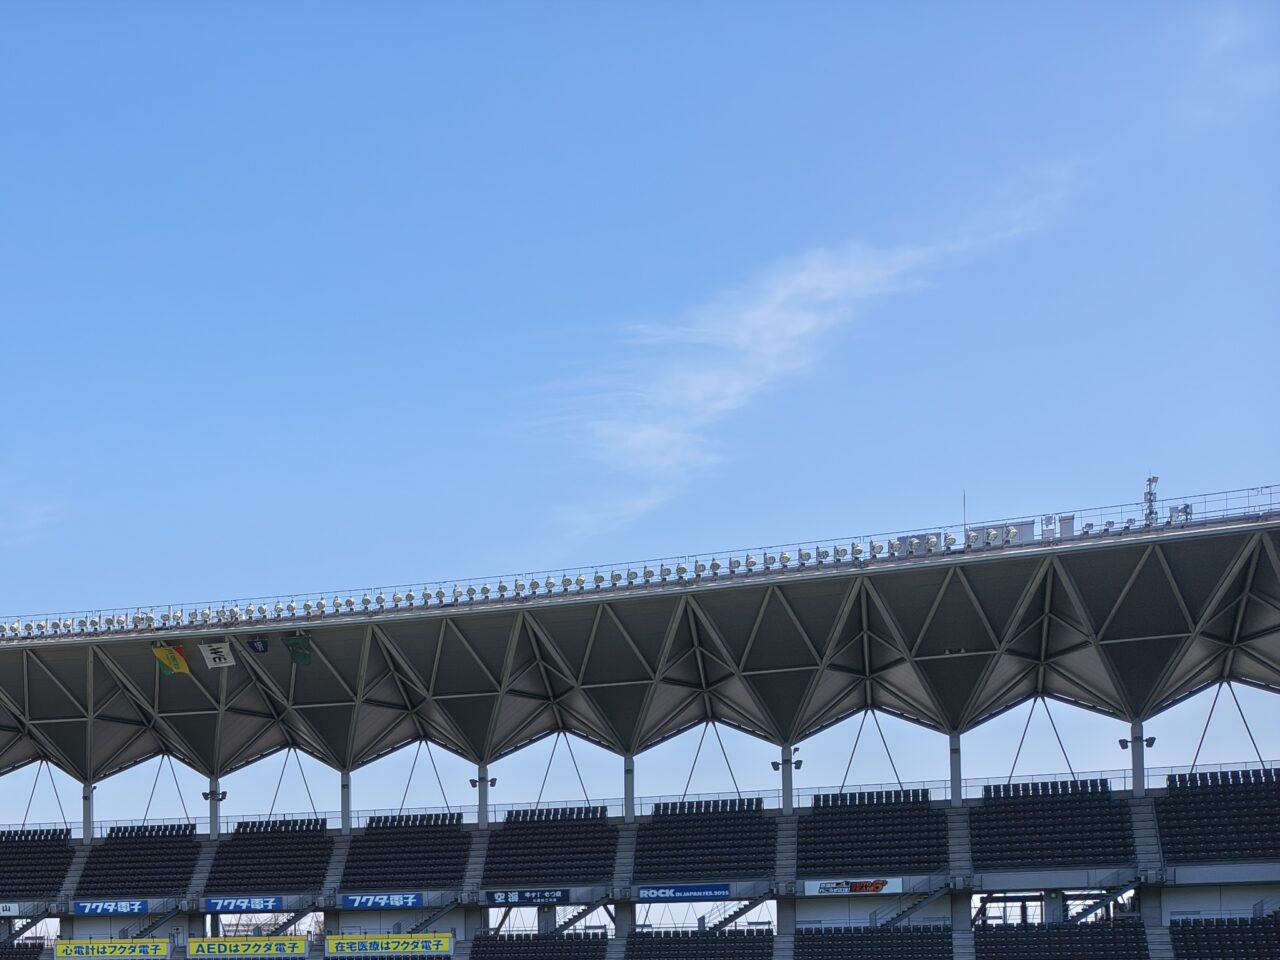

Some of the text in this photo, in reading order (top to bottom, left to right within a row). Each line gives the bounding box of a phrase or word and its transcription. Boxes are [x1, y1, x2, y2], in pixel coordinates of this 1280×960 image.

[639, 888, 675, 898] ROCK
[80, 901, 142, 913] フクダ電子
[211, 898, 276, 910] フクダ電子
[349, 894, 417, 907] フクダ電子
[62, 944, 162, 957] 心電計はフクダ電子
[195, 942, 299, 955] AEDはフクダ電子
[334, 939, 444, 952] 在宅医療はフクダ電子
